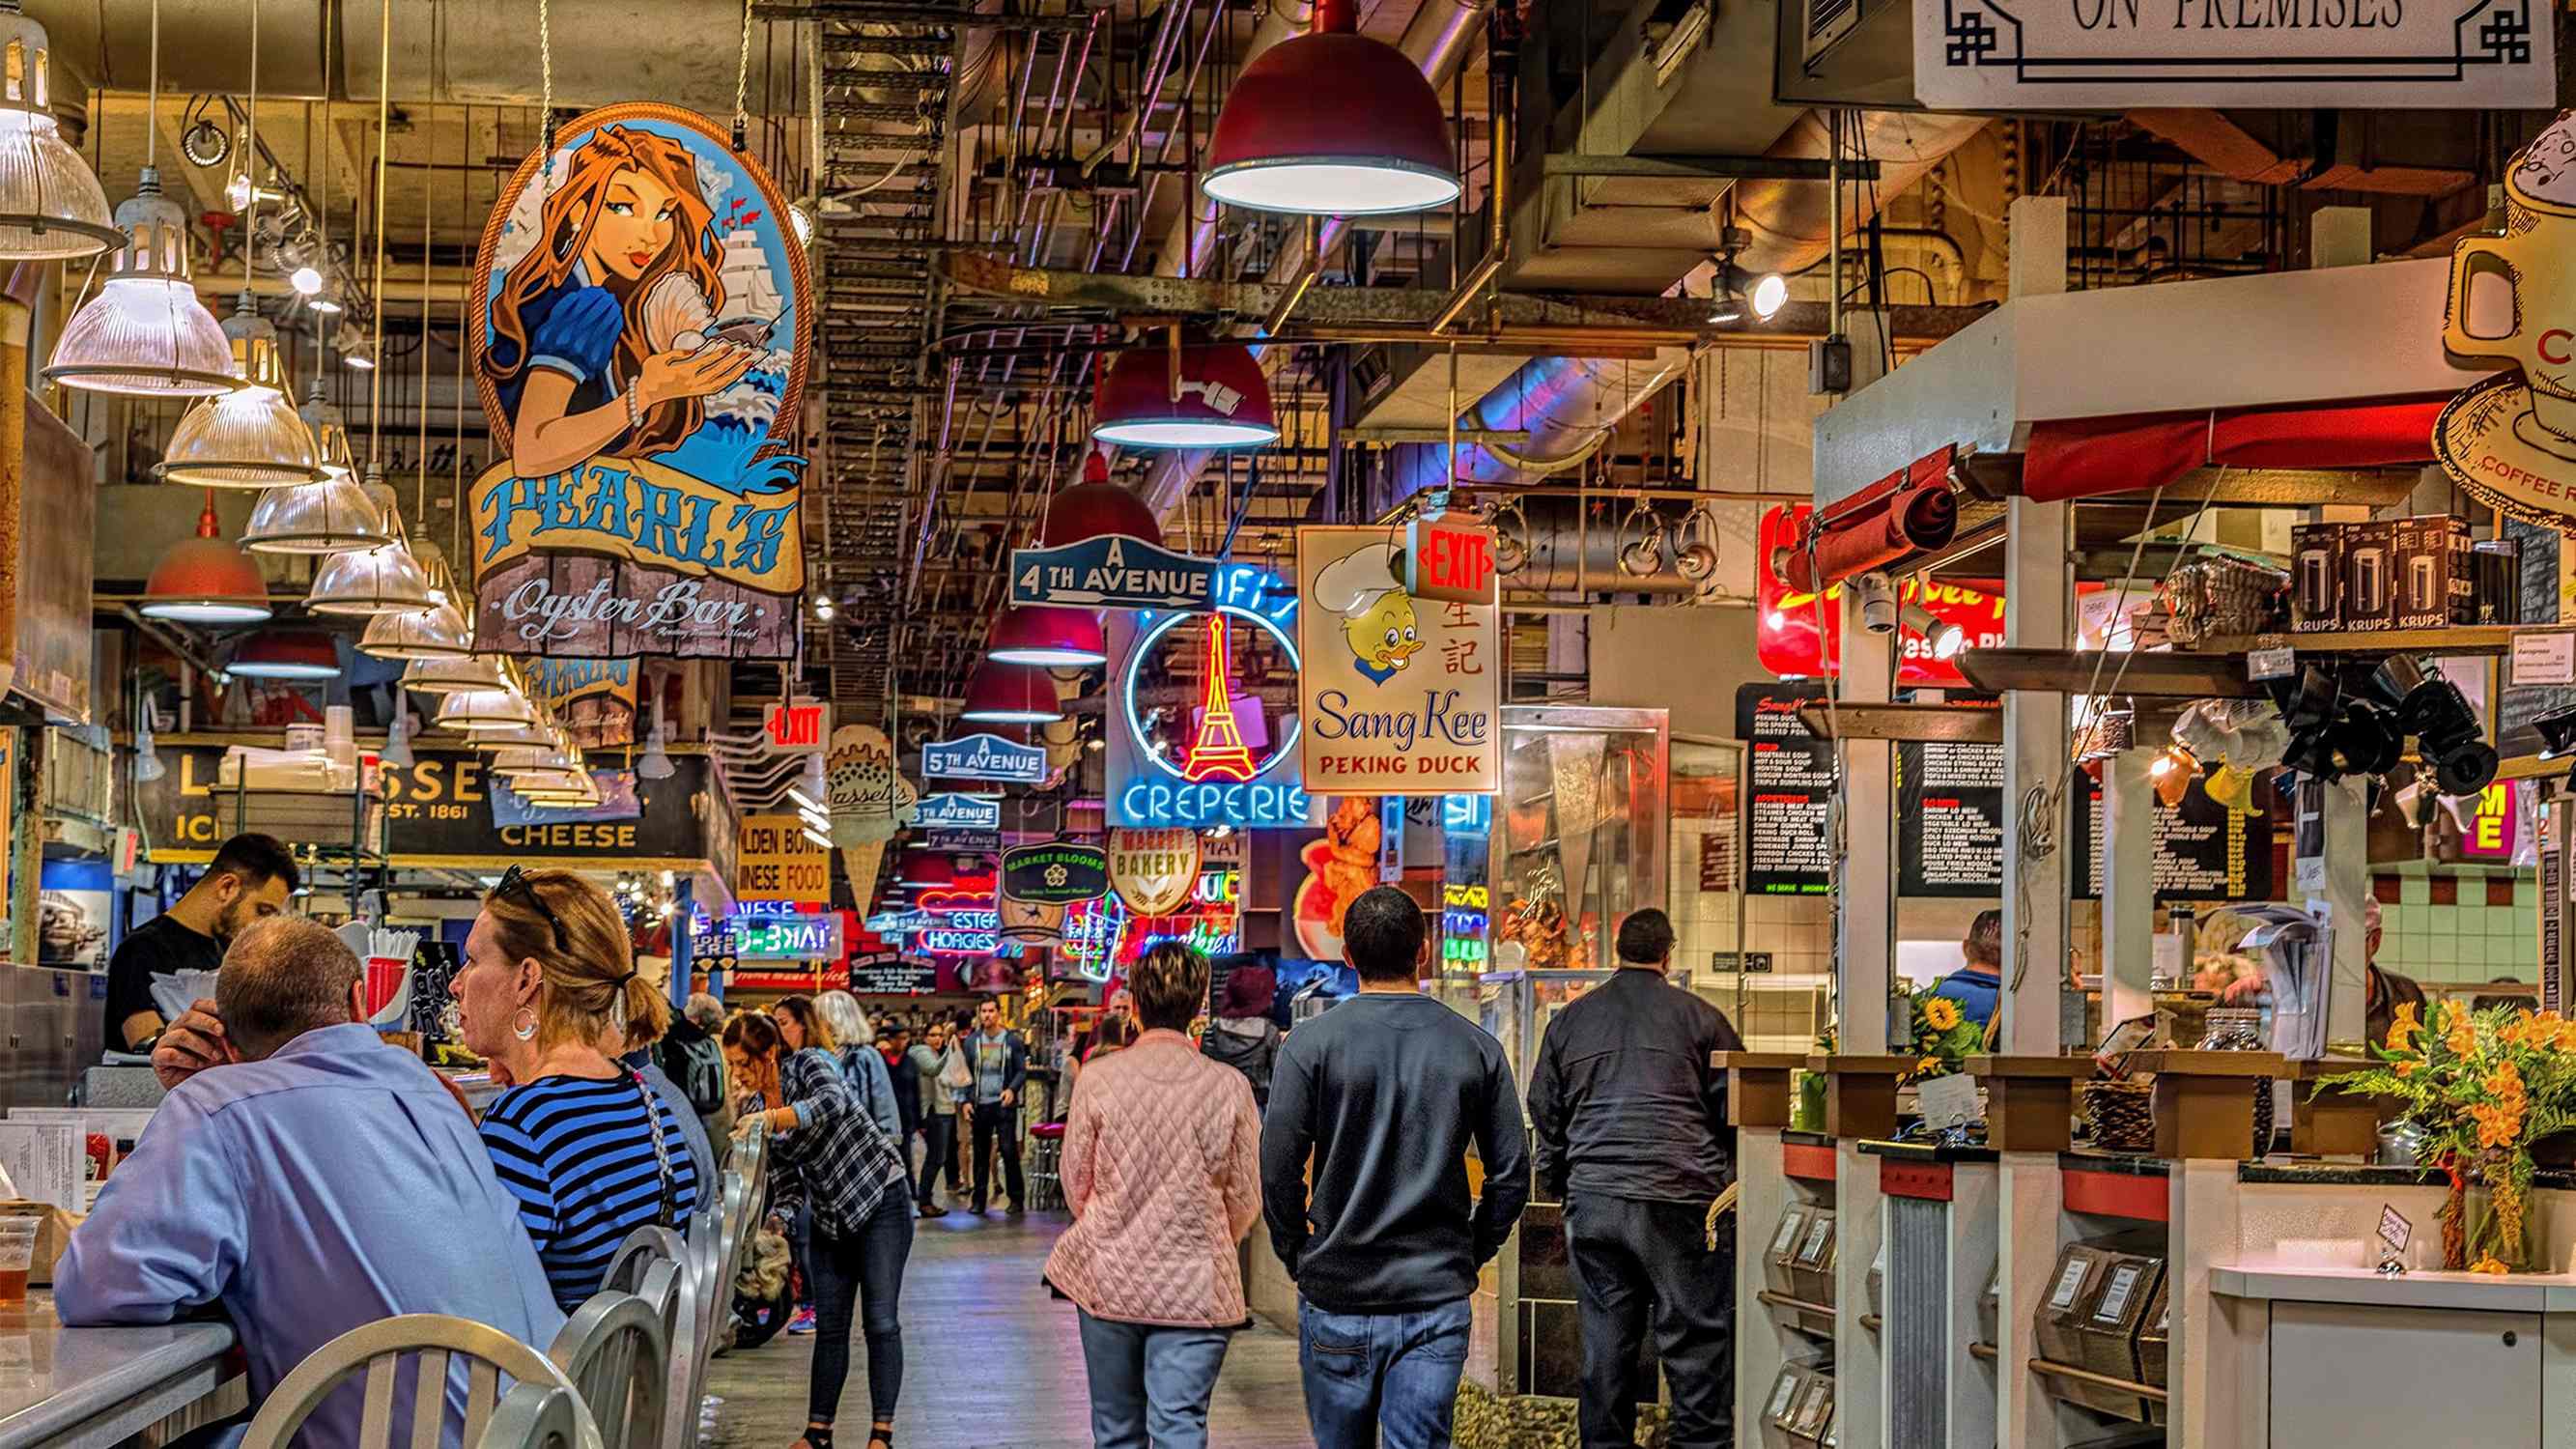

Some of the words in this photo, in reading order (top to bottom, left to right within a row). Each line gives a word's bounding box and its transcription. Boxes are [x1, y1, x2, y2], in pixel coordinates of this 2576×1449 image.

[2075, 0, 2142, 30] ON
[2174, 0, 2403, 30] PREMISES
[2482, 455, 2561, 498] COFFEE
[482, 462, 798, 575] PEARL'S
[1430, 530, 1485, 591] EXIT
[1083, 566, 1207, 597] AVENUE
[502, 579, 643, 641] Oyster
[638, 579, 750, 630] Bar
[2399, 613, 2445, 629] KRUPS
[2295, 618, 2337, 633] KRUPS
[2348, 618, 2392, 633] KRUPS
[775, 707, 822, 746] EXIT
[1314, 690, 1417, 753] Sang
[1421, 689, 1486, 750] Kee
[966, 756, 1039, 772] AVENUE
[1320, 756, 1406, 774] PEKING
[1418, 755, 1481, 774] DUCK
[430, 805, 468, 819] 1861
[1123, 783, 1309, 820] CREPERIE
[938, 808, 994, 819] AVENUE
[500, 825, 637, 847] CHEESE
[784, 828, 824, 854] BO
[954, 835, 998, 844] AVENUE
[1122, 830, 1183, 851] MARKET
[1006, 853, 1054, 871] MARKET
[1057, 854, 1105, 871] BLOOMS
[1116, 853, 1189, 876] BAKERY
[787, 865, 824, 891] FOOD
[929, 932, 996, 951] HOAGIES
